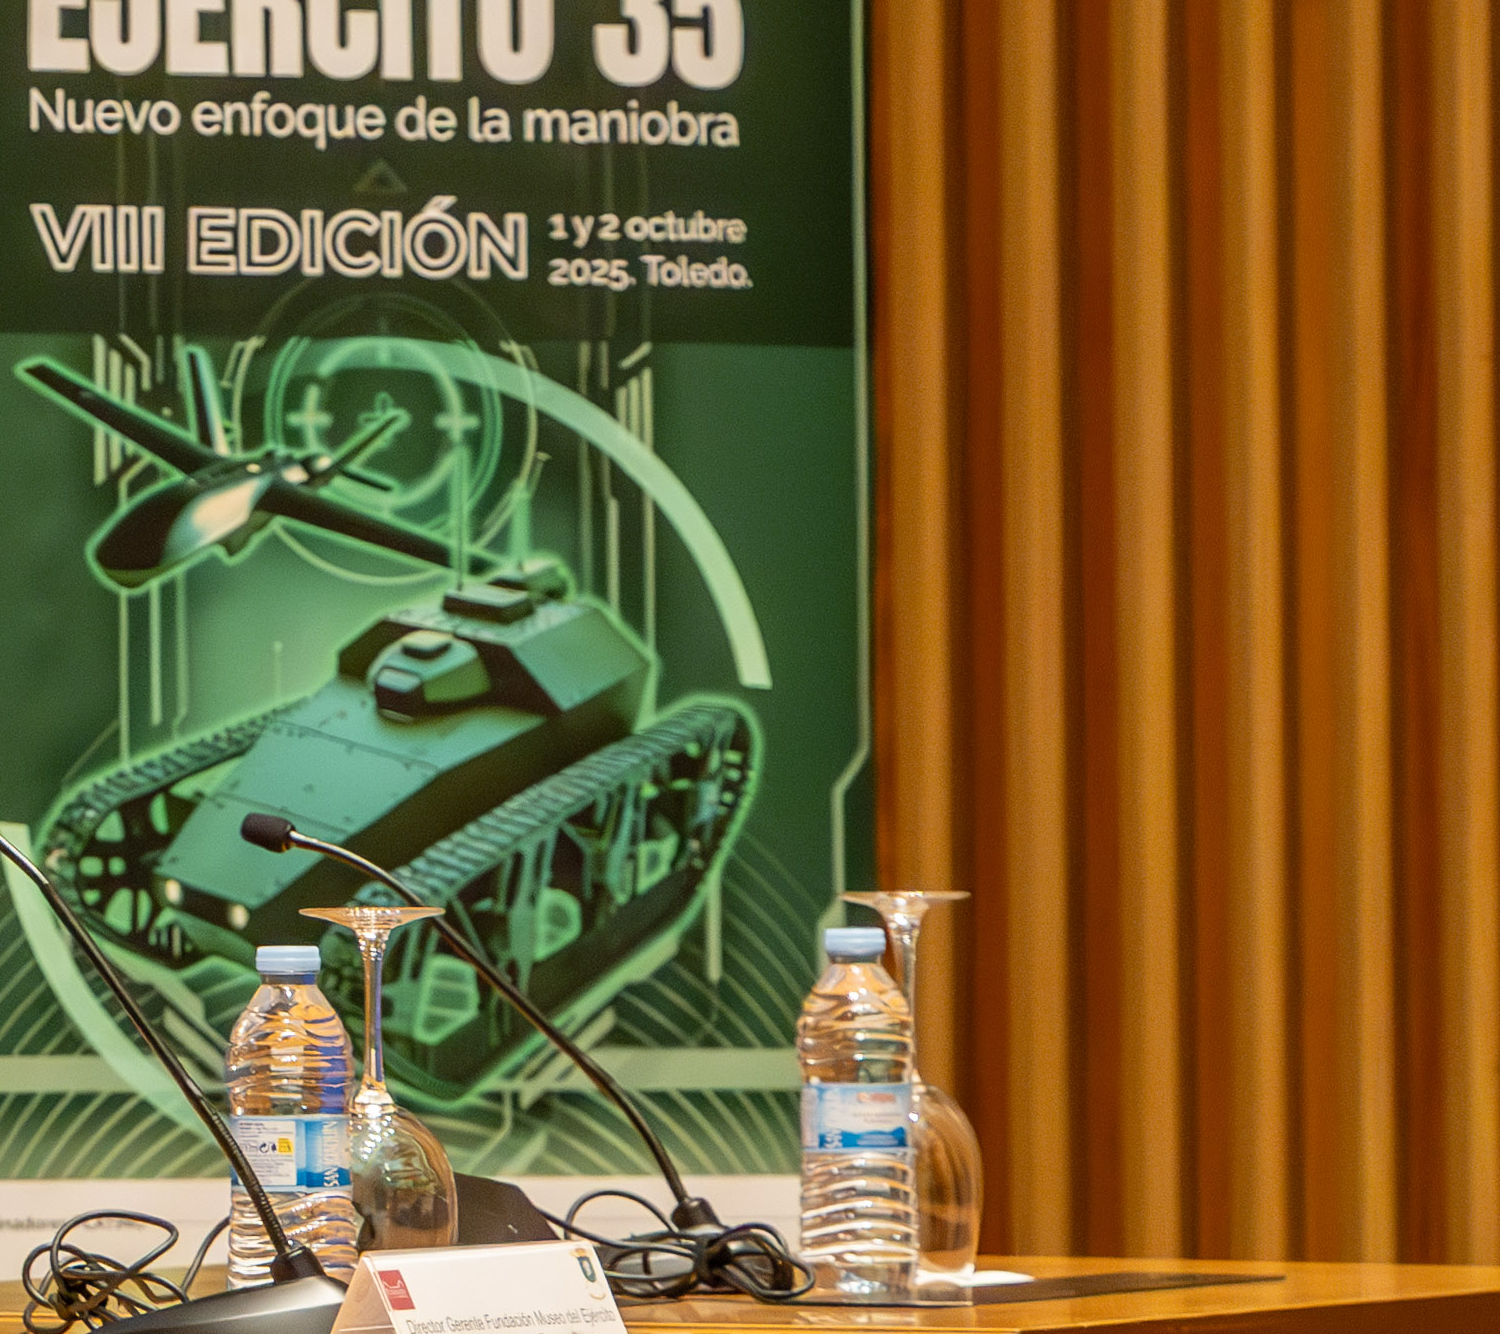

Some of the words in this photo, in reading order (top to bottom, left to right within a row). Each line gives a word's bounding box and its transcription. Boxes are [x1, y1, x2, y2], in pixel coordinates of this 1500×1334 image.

[28, 86, 182, 136] Nuevo
[191, 90, 387, 152] enfoque
[394, 95, 458, 142] de
[467, 95, 512, 143] la
[522, 98, 741, 148] maniobra
[29, 203, 166, 275] VIII
[186, 194, 529, 281] EDICIÓN
[548, 213, 568, 241] 1
[571, 215, 595, 249] y
[597, 213, 622, 242] 2
[623, 210, 748, 244] octubre
[546, 258, 637, 292] 2025.
[638, 254, 754, 290] Toledo.
[446, 1316, 484, 1333] Gerente
[484, 1313, 534, 1331] Fundación
[534, 1310, 566, 1326] Museo
[566, 1309, 581, 1324] del
